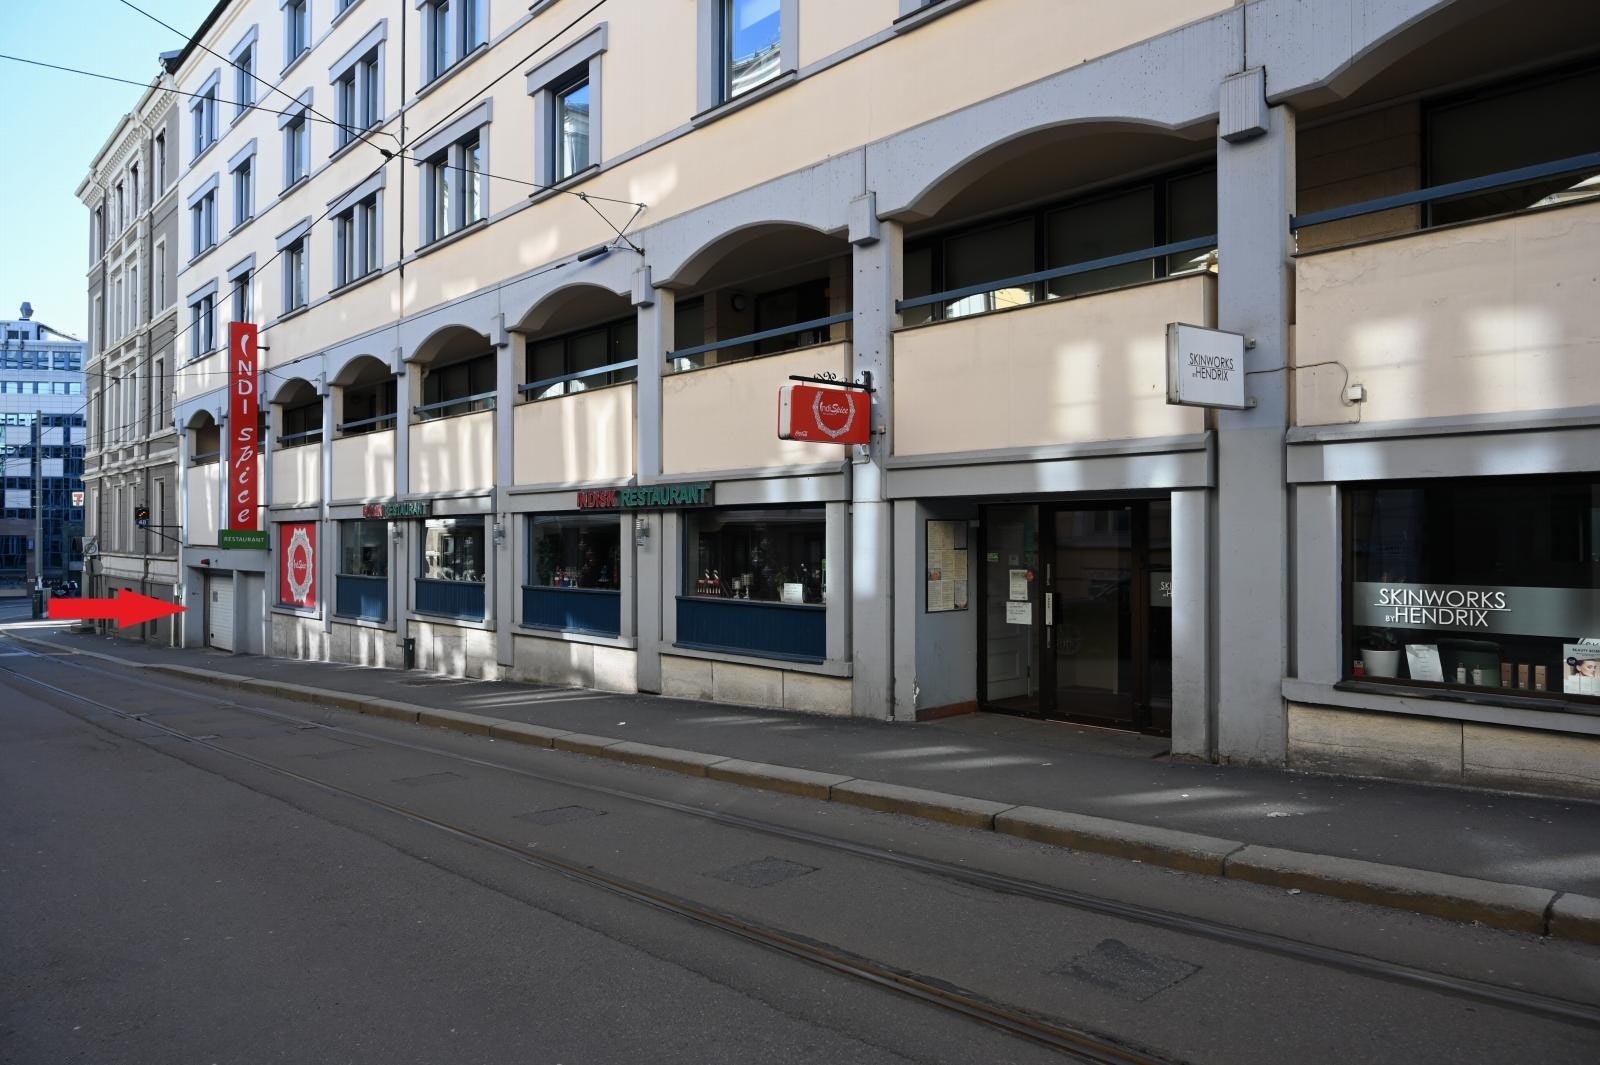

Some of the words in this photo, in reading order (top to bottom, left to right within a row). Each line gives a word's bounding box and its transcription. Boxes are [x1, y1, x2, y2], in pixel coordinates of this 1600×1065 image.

[1189, 352, 1234, 370] SKINWORKS
[1195, 366, 1229, 381] HENDRIX
[577, 489, 616, 508] INDISK
[621, 481, 710, 506] RESTAURANT
[1379, 588, 1506, 609] SKINWORKS
[1395, 606, 1488, 627] HENDRIX
